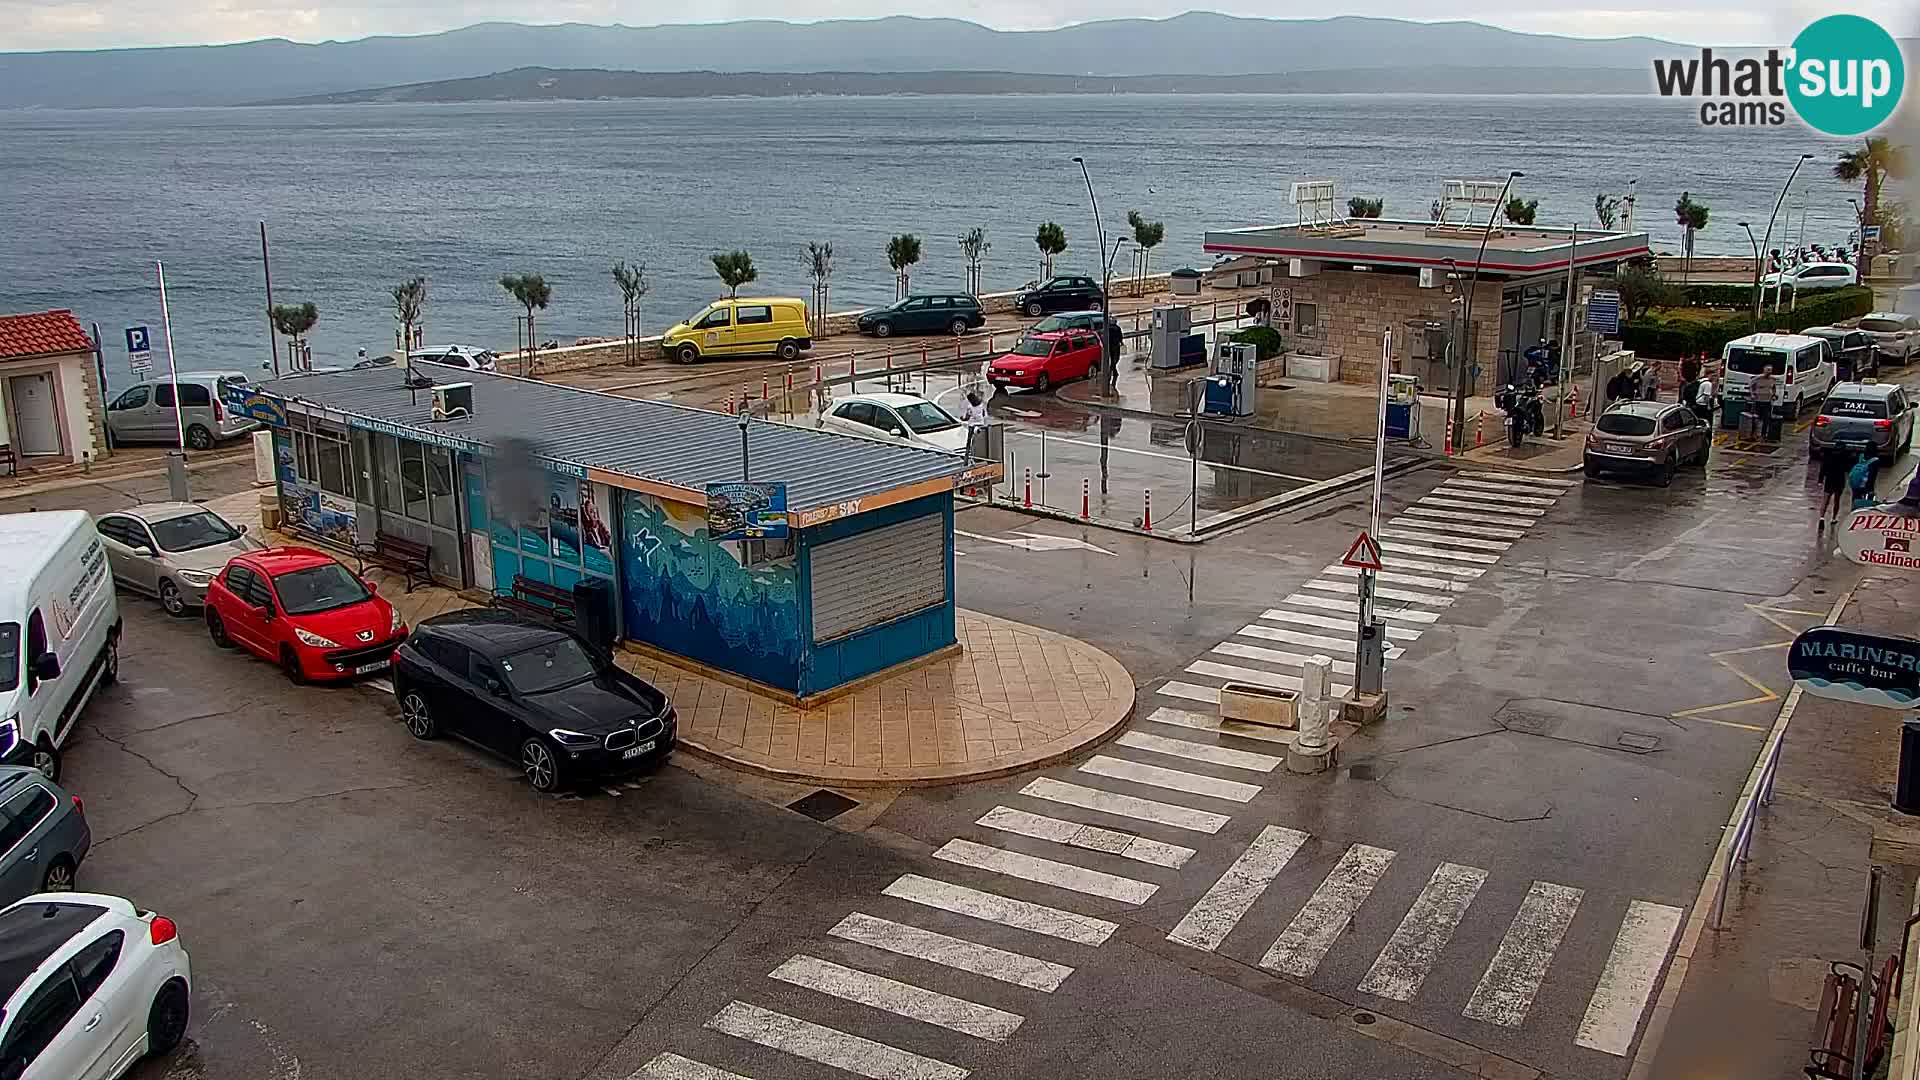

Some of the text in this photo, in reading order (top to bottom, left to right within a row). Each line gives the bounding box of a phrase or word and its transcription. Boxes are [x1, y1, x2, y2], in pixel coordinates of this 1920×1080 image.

[131, 330, 144, 348] P
[1843, 401, 1866, 410] TAXI
[397, 426, 437, 444] AUTOBUSNA
[437, 436, 468, 450] POSTAJA
[556, 462, 583, 476] OFFICE
[839, 498, 862, 517] SKY
[1882, 530, 1917, 540] GRILL
[1828, 662, 1897, 680] caffe bar
